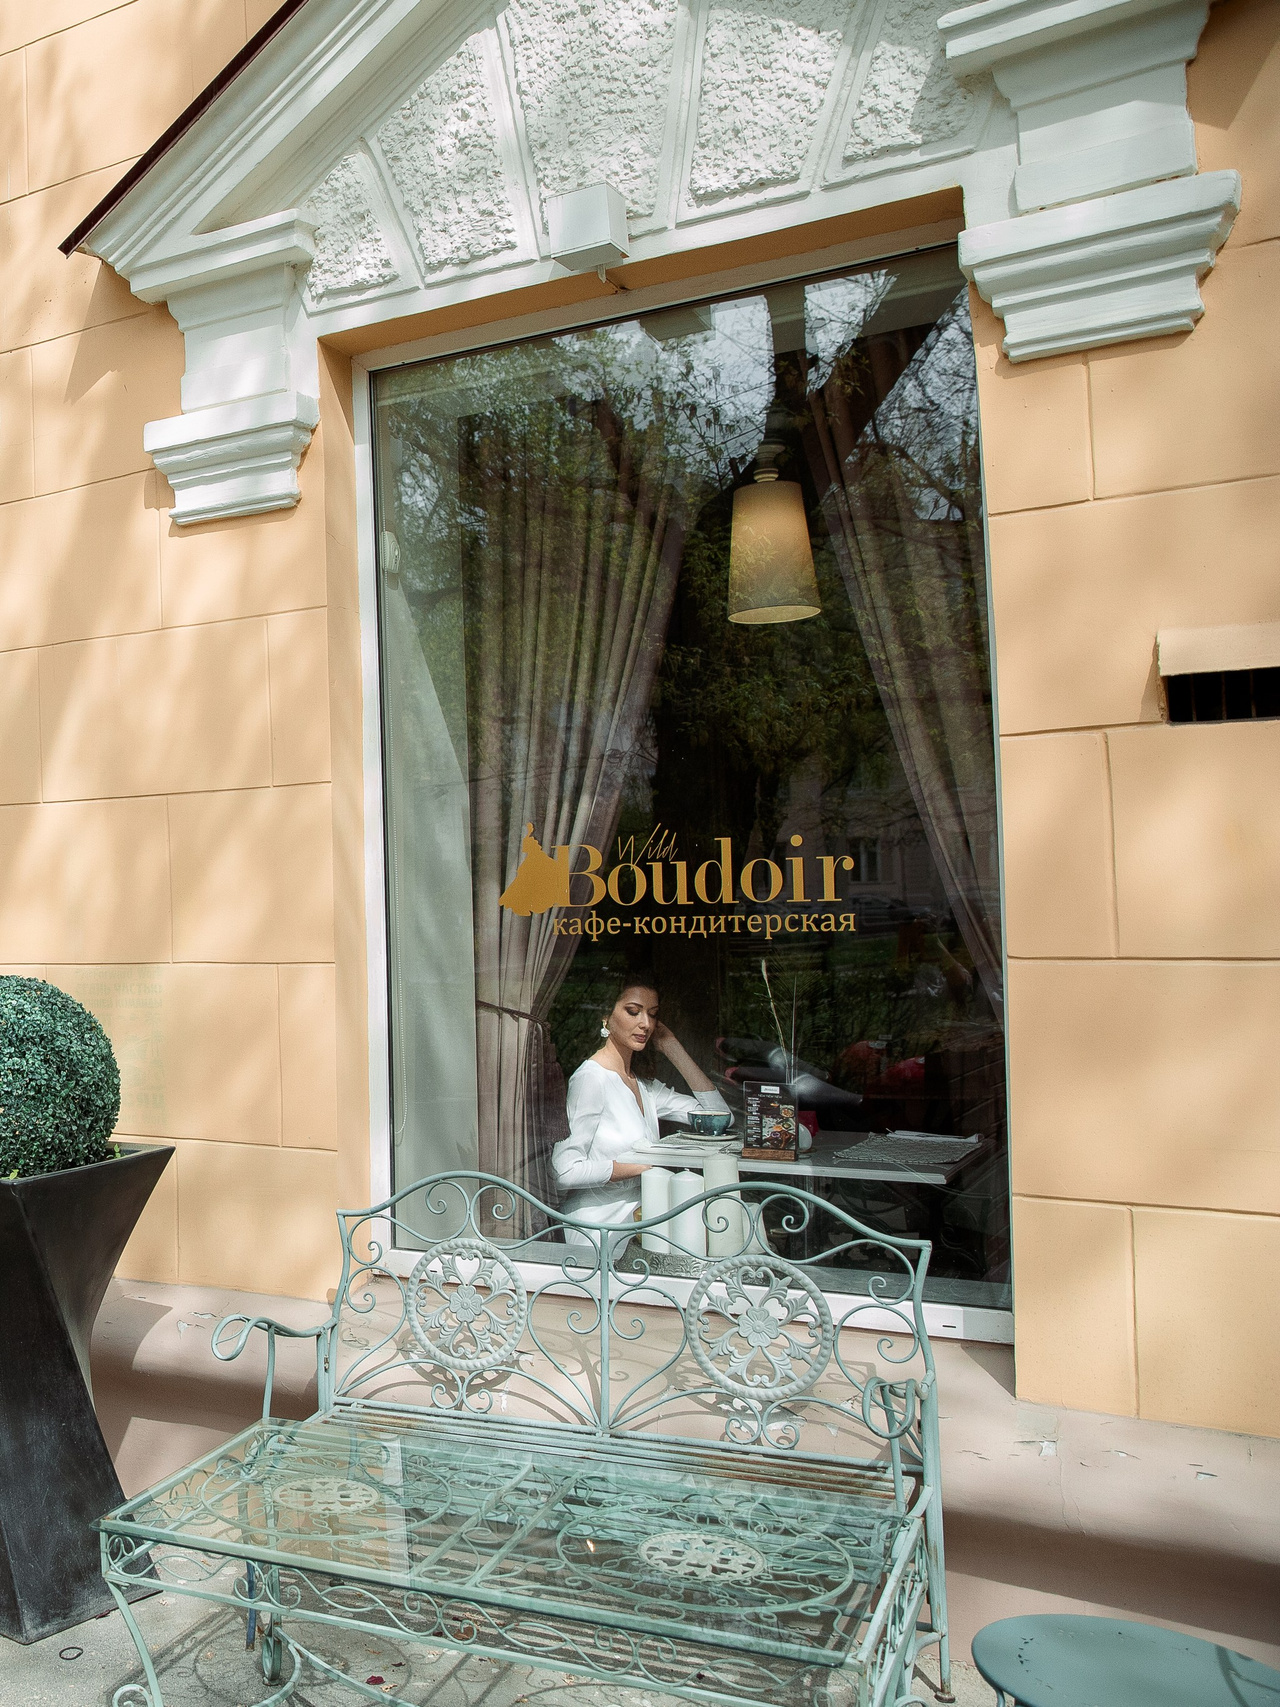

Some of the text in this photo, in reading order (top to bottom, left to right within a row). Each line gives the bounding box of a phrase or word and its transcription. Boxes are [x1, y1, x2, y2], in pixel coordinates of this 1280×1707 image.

[551, 834, 855, 908] Boudoir
[617, 823, 679, 871] Wild
[552, 910, 857, 942] кафе-кондитерская
